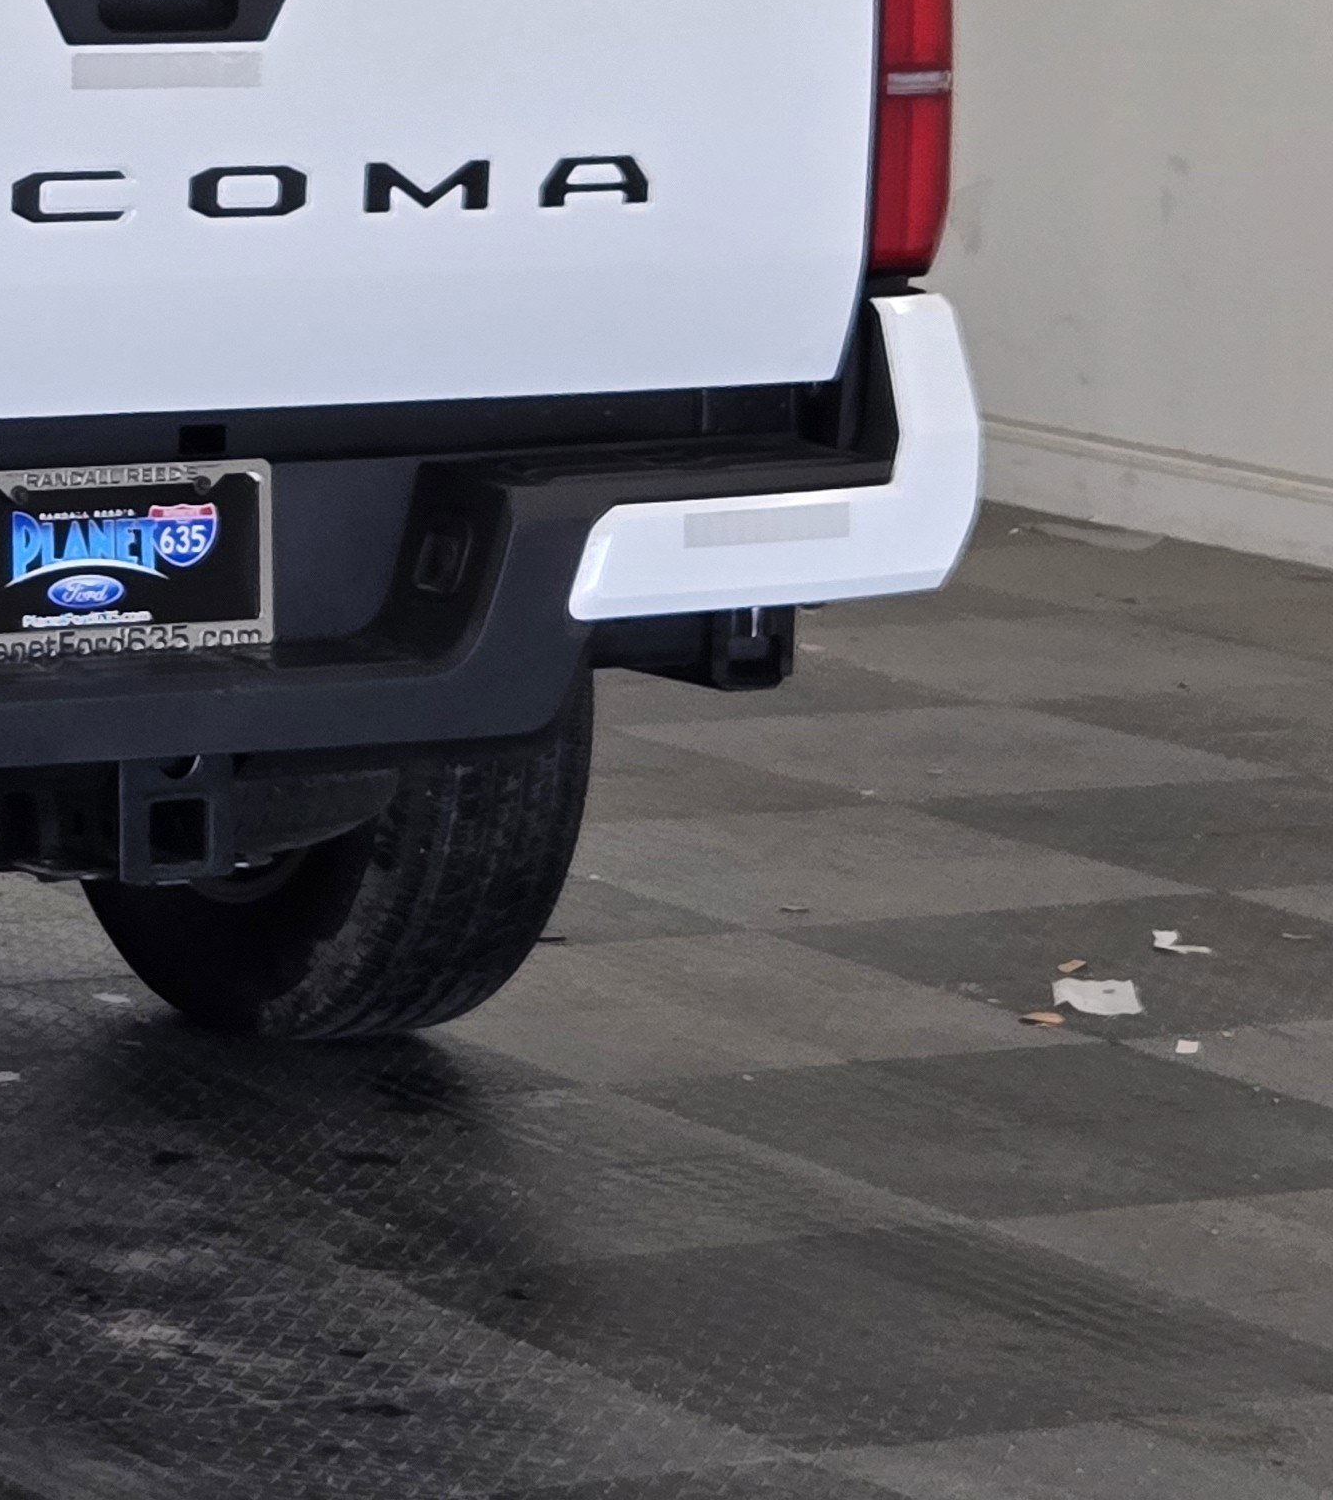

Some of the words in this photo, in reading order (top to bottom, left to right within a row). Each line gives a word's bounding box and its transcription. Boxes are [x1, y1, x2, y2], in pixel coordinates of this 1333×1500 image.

[12, 511, 158, 581] PLANET
[159, 524, 208, 555] 635
[61, 582, 109, 603] Ford
